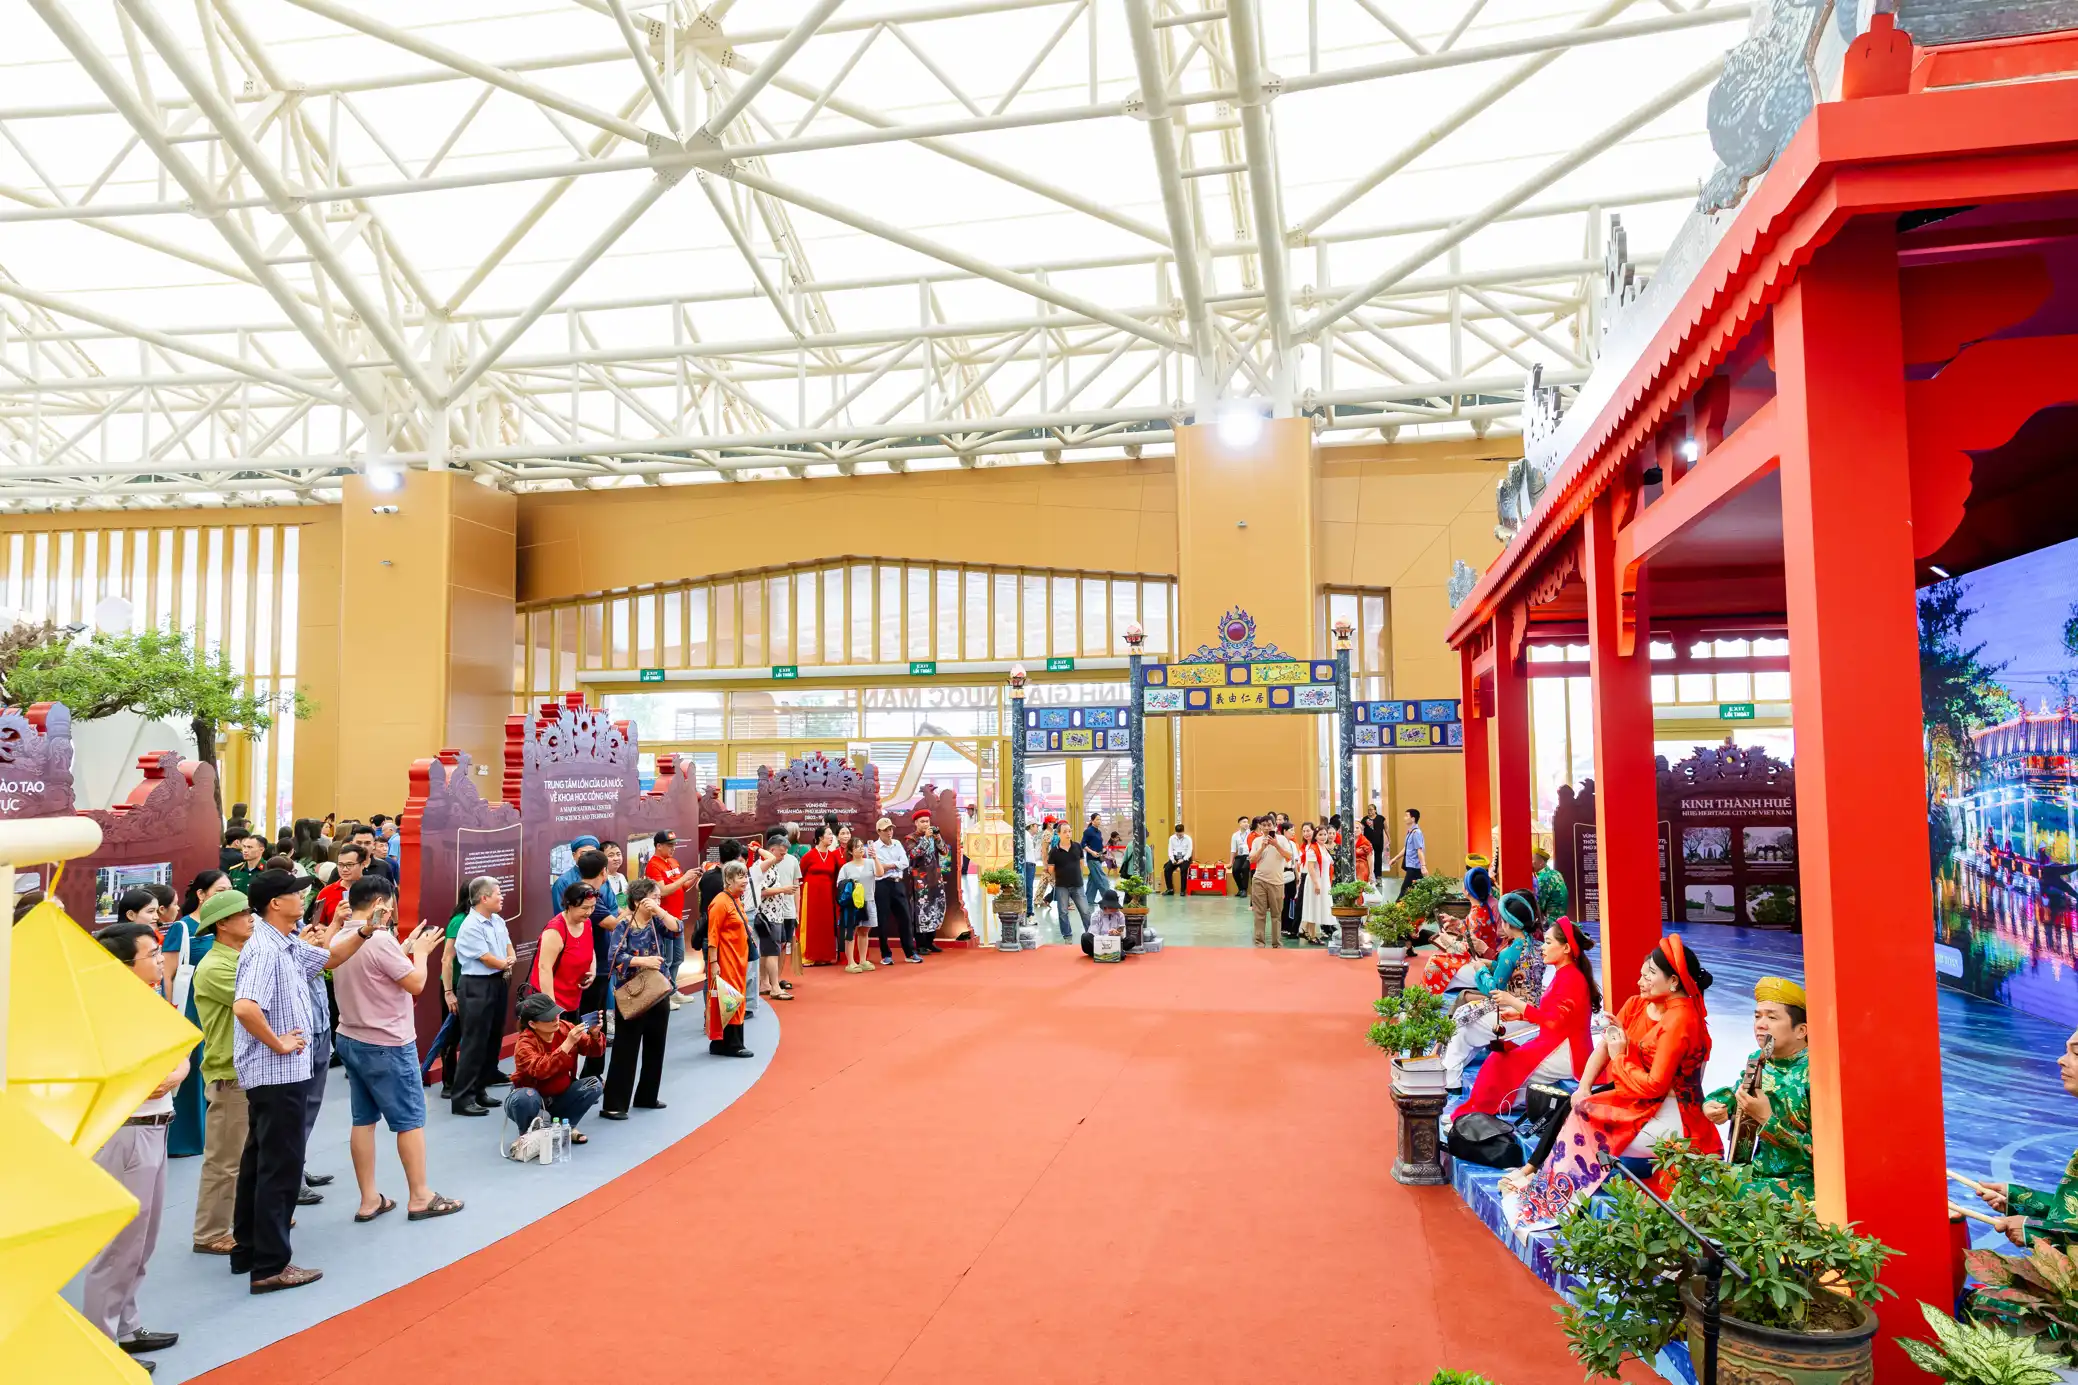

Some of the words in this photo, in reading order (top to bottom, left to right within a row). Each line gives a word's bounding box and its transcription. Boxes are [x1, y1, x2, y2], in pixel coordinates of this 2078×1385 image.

[0, 778, 18, 793] ÀO
[19, 781, 45, 796] TẠO
[544, 780, 564, 790] TRUNG
[565, 778, 578, 789] TÂM
[558, 793, 574, 802] KHOA
[588, 790, 604, 801] CÔNG
[1681, 800, 1714, 808] KINH
[1716, 798, 1761, 808] THÀNH
[1764, 796, 1792, 808] HUẾ
[0, 798, 20, 814] ỰC
